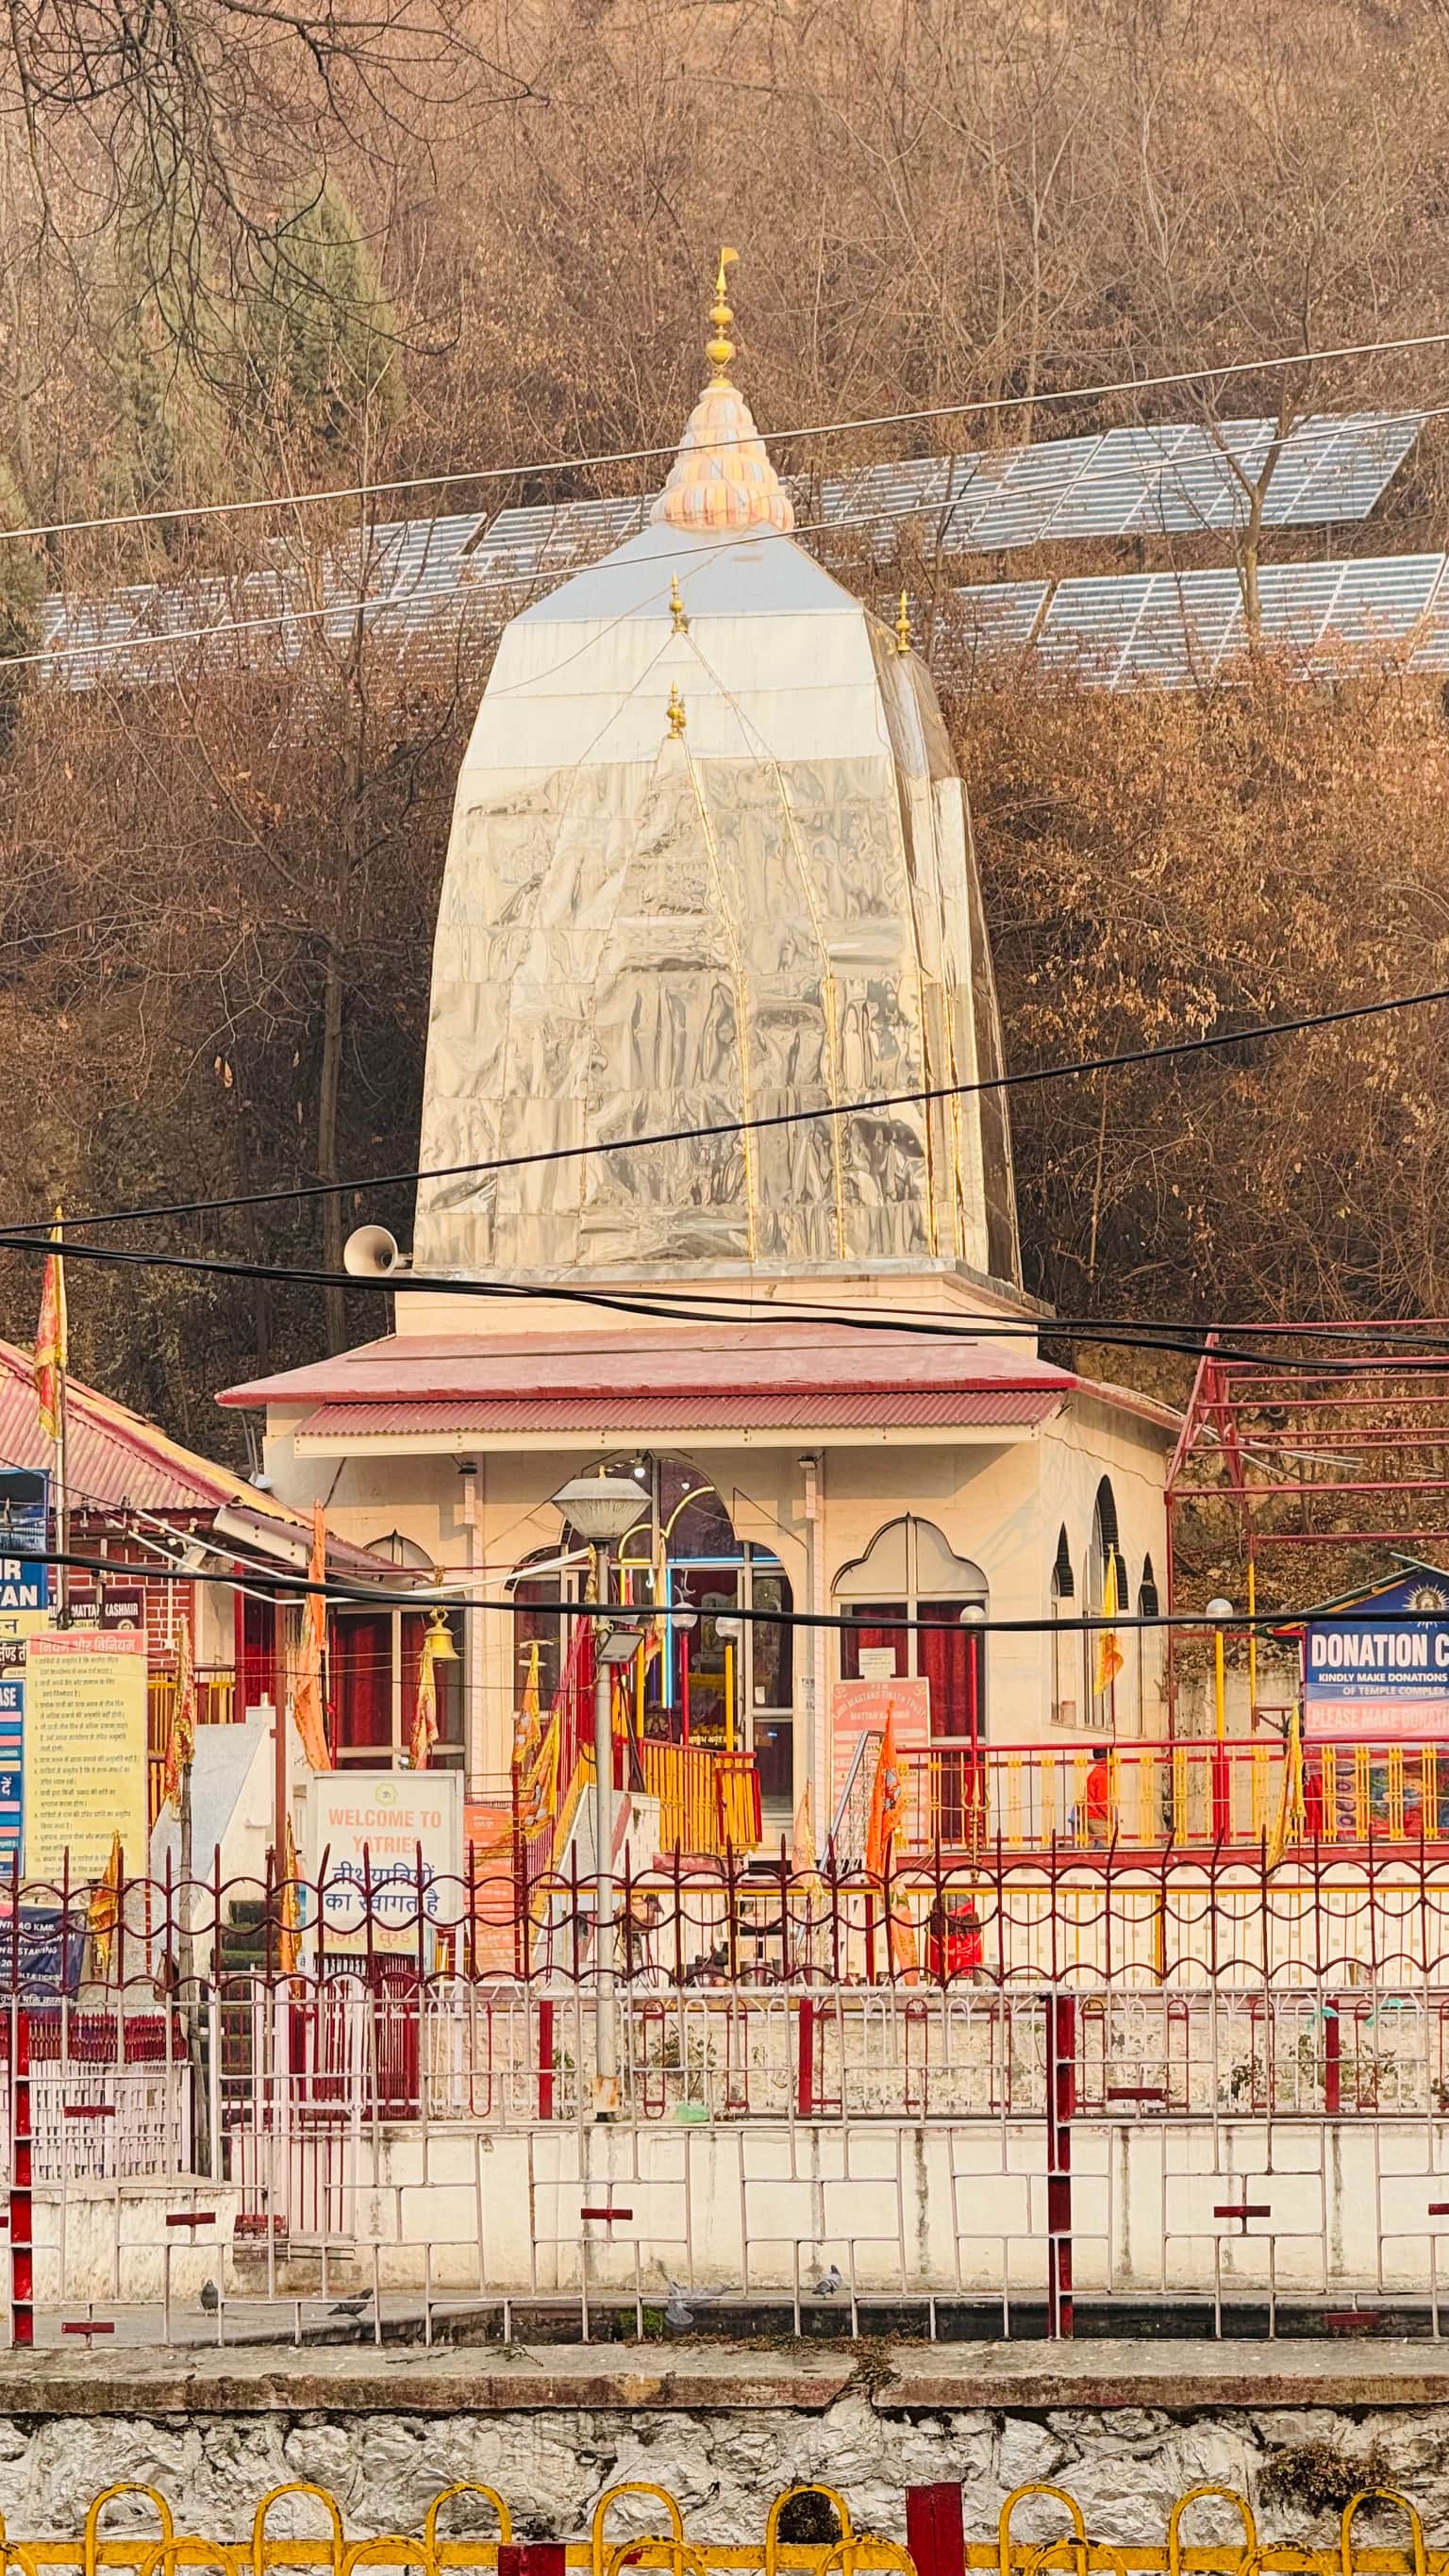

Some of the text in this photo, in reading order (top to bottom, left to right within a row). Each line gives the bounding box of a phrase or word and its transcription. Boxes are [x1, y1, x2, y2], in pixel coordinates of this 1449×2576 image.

[0, 1585, 38, 1607] AN
[1311, 1634, 1428, 1668] DONATION
[1319, 1673, 1448, 1682] KINDLY MAKE DONATIONS
[1343, 1687, 1445, 1696] OF TEMPLE COMPLEX
[1312, 1707, 1358, 1728] PLEASE
[1362, 1707, 1399, 1728] MAKE
[328, 1809, 441, 1828] WELCOME TO
[325, 1893, 352, 1912] का
[425, 1888, 441, 1917] है
